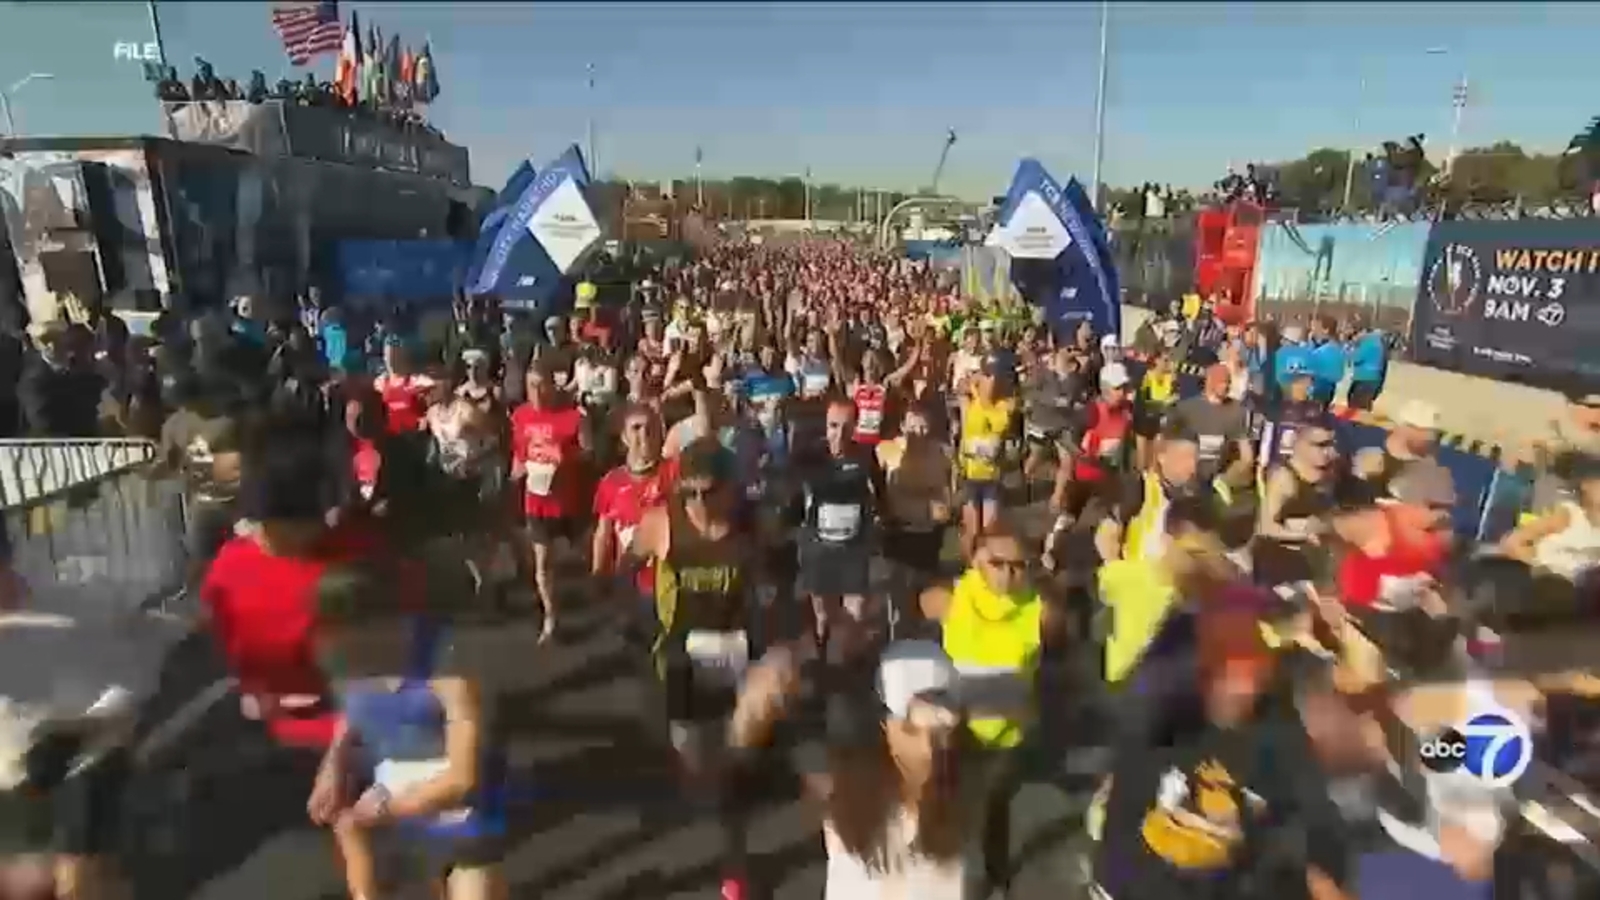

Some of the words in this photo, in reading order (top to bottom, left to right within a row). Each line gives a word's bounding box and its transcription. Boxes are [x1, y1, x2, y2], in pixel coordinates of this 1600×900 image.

[1495, 249, 1582, 273] WATCH
[1486, 274, 1540, 297] NOV.
[1547, 277, 1566, 299] 3
